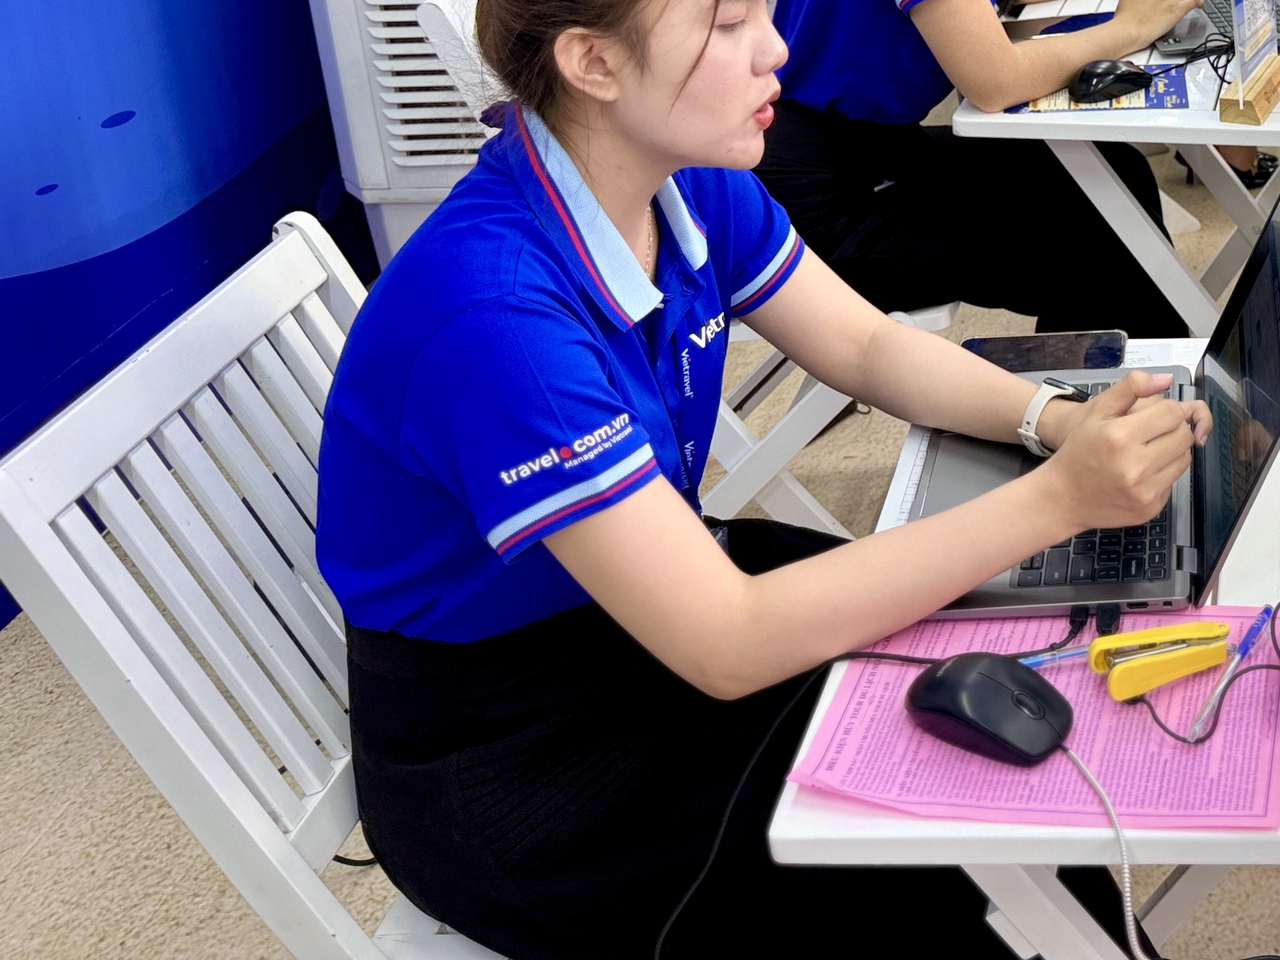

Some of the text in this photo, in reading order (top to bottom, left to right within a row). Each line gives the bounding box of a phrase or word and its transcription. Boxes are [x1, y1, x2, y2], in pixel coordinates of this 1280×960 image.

[564, 425, 633, 470] Managed by Vietravel
[851, 699, 864, 720] TOUR
[859, 689, 868, 699] DU
